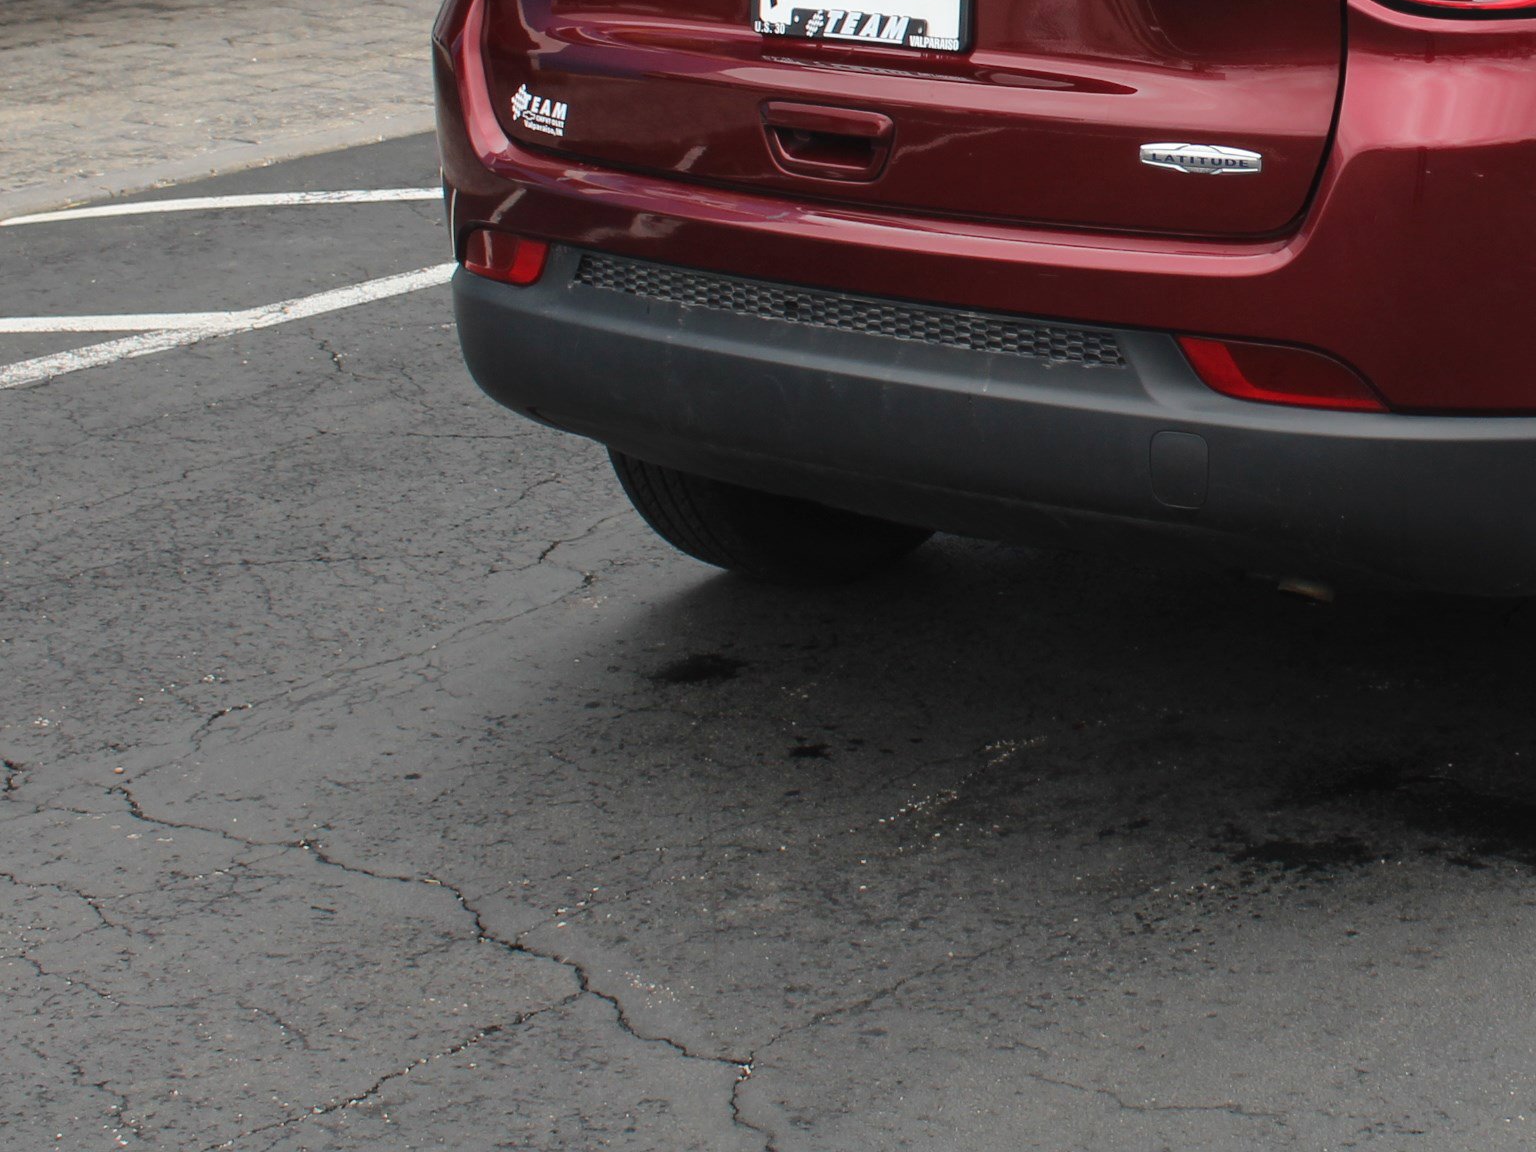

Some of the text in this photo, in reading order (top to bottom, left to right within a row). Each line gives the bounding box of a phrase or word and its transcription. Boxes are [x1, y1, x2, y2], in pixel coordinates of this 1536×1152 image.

[754, 20, 786, 35] U.S. 30
[824, 10, 910, 40] TEAM
[909, 35, 959, 51] VALPARAISO
[522, 92, 568, 121] TEAM
[1151, 152, 1250, 168] LATITUDE
